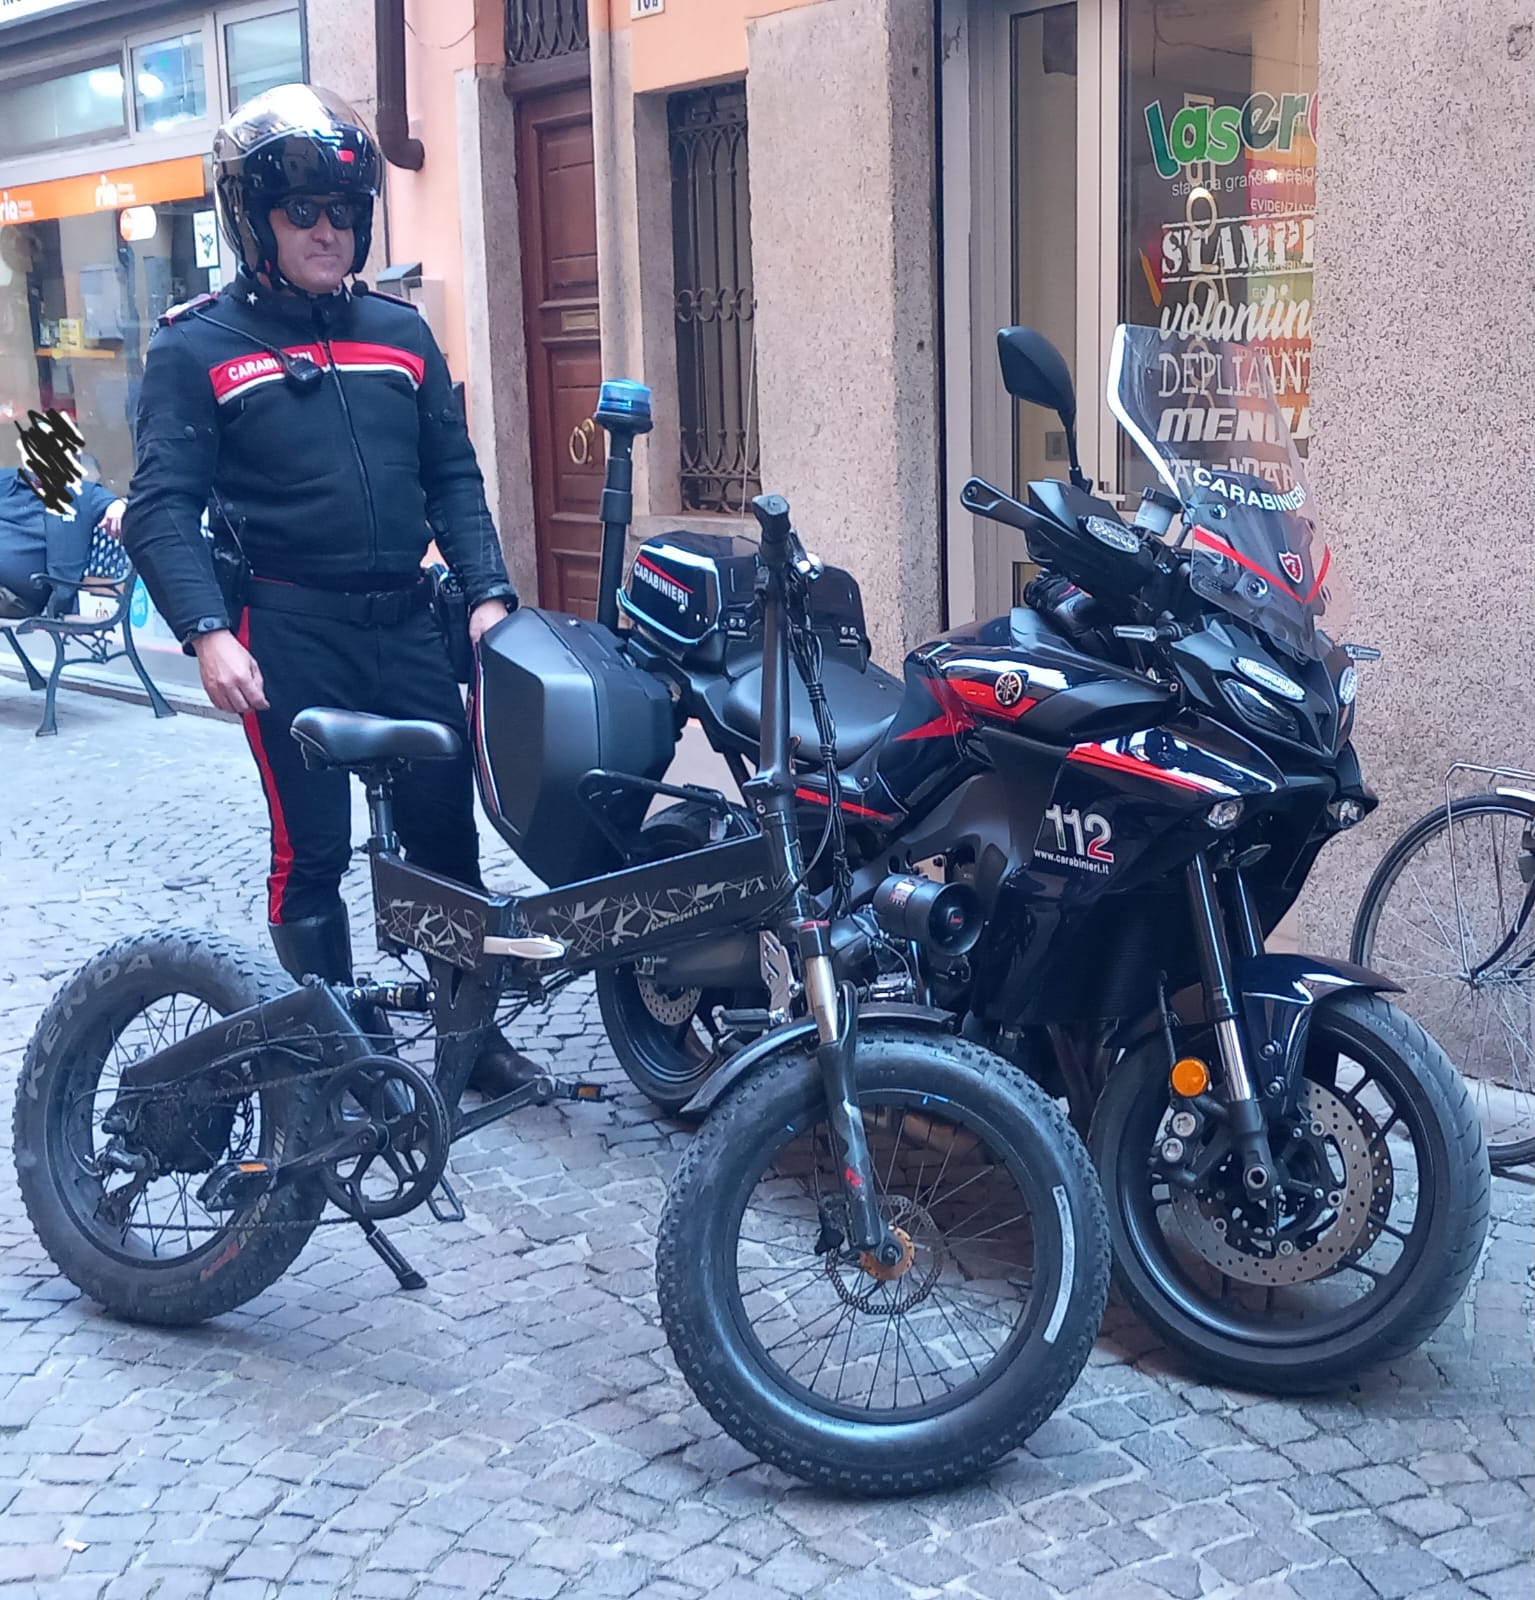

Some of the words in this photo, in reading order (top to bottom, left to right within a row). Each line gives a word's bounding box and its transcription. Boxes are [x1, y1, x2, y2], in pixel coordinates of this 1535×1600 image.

[1144, 91, 1319, 179] laser
[1172, 178, 1221, 197] stapa
[1158, 284, 1312, 342] volantin
[1193, 467, 1307, 511] CARABINIERI
[634, 561, 689, 607] CARABINIERI
[1045, 803, 1114, 863] 112
[1034, 849, 1109, 875] www.carabinieri.it
[25, 953, 153, 1100] KENDA
